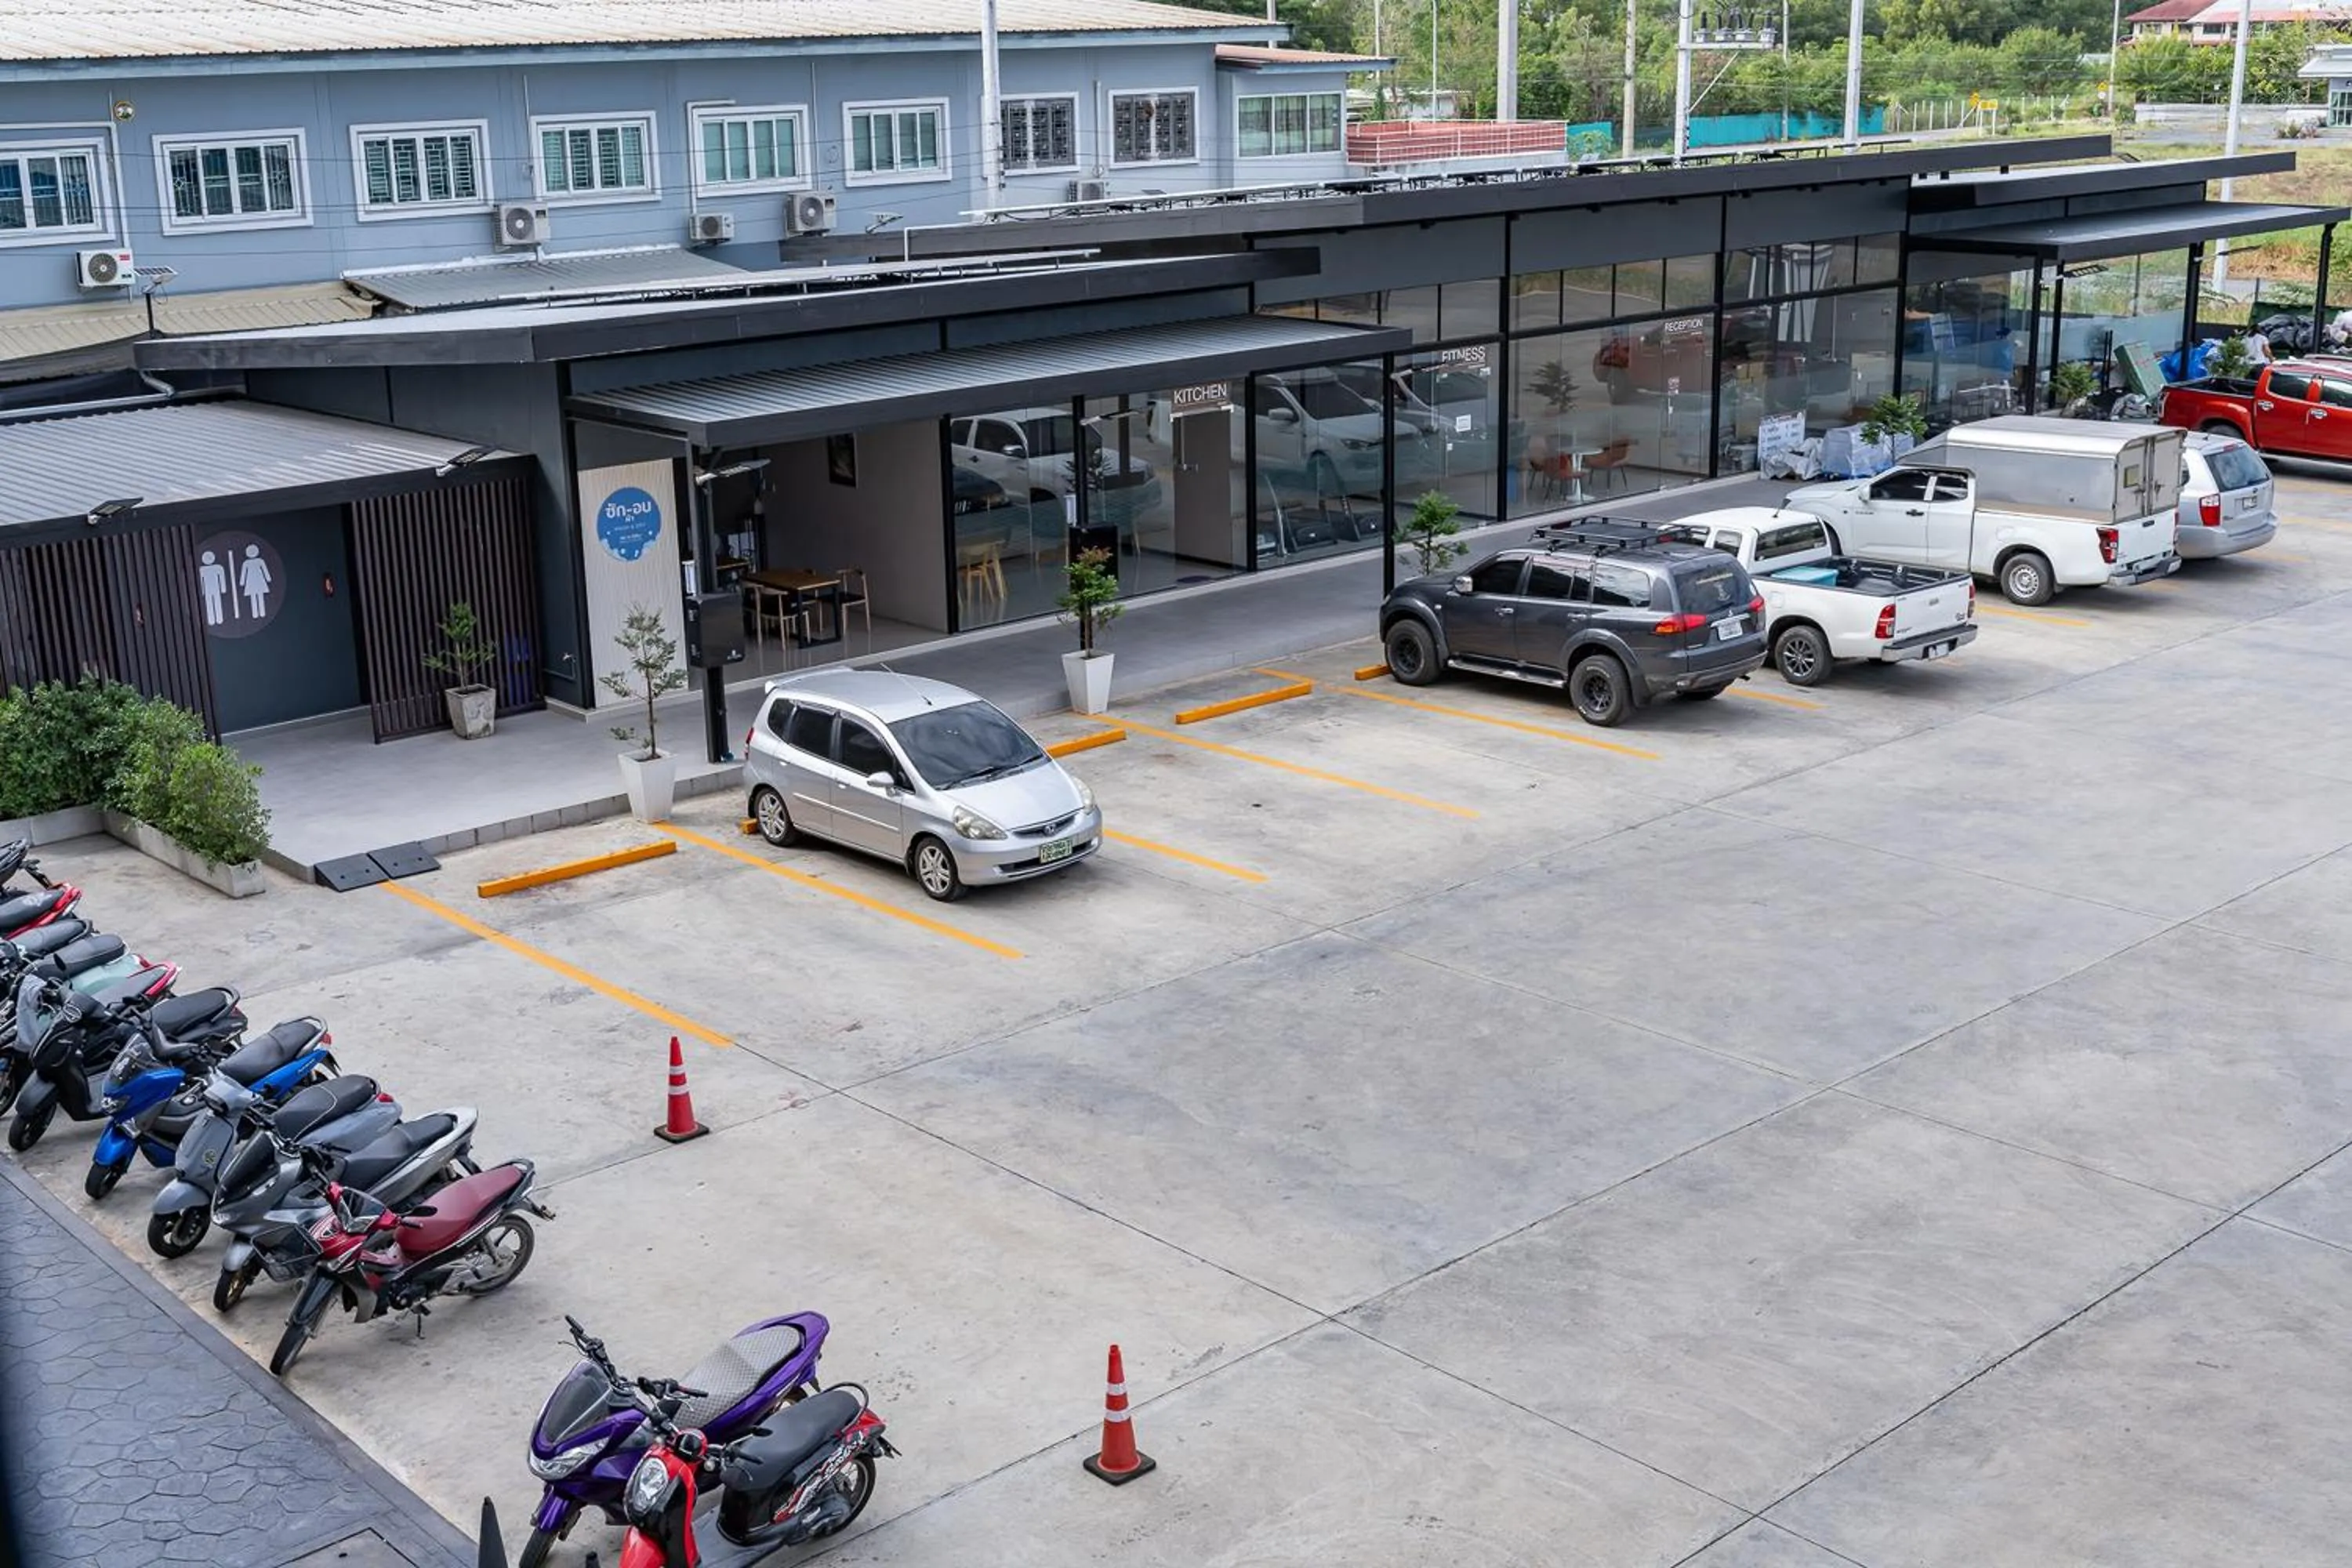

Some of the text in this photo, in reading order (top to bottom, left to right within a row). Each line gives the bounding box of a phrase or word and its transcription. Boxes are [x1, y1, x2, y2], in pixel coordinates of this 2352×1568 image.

[1664, 318, 1704, 332] RECEPTION
[1442, 346, 1486, 362] FITNESS
[1174, 383, 1227, 404] KITCHEN
